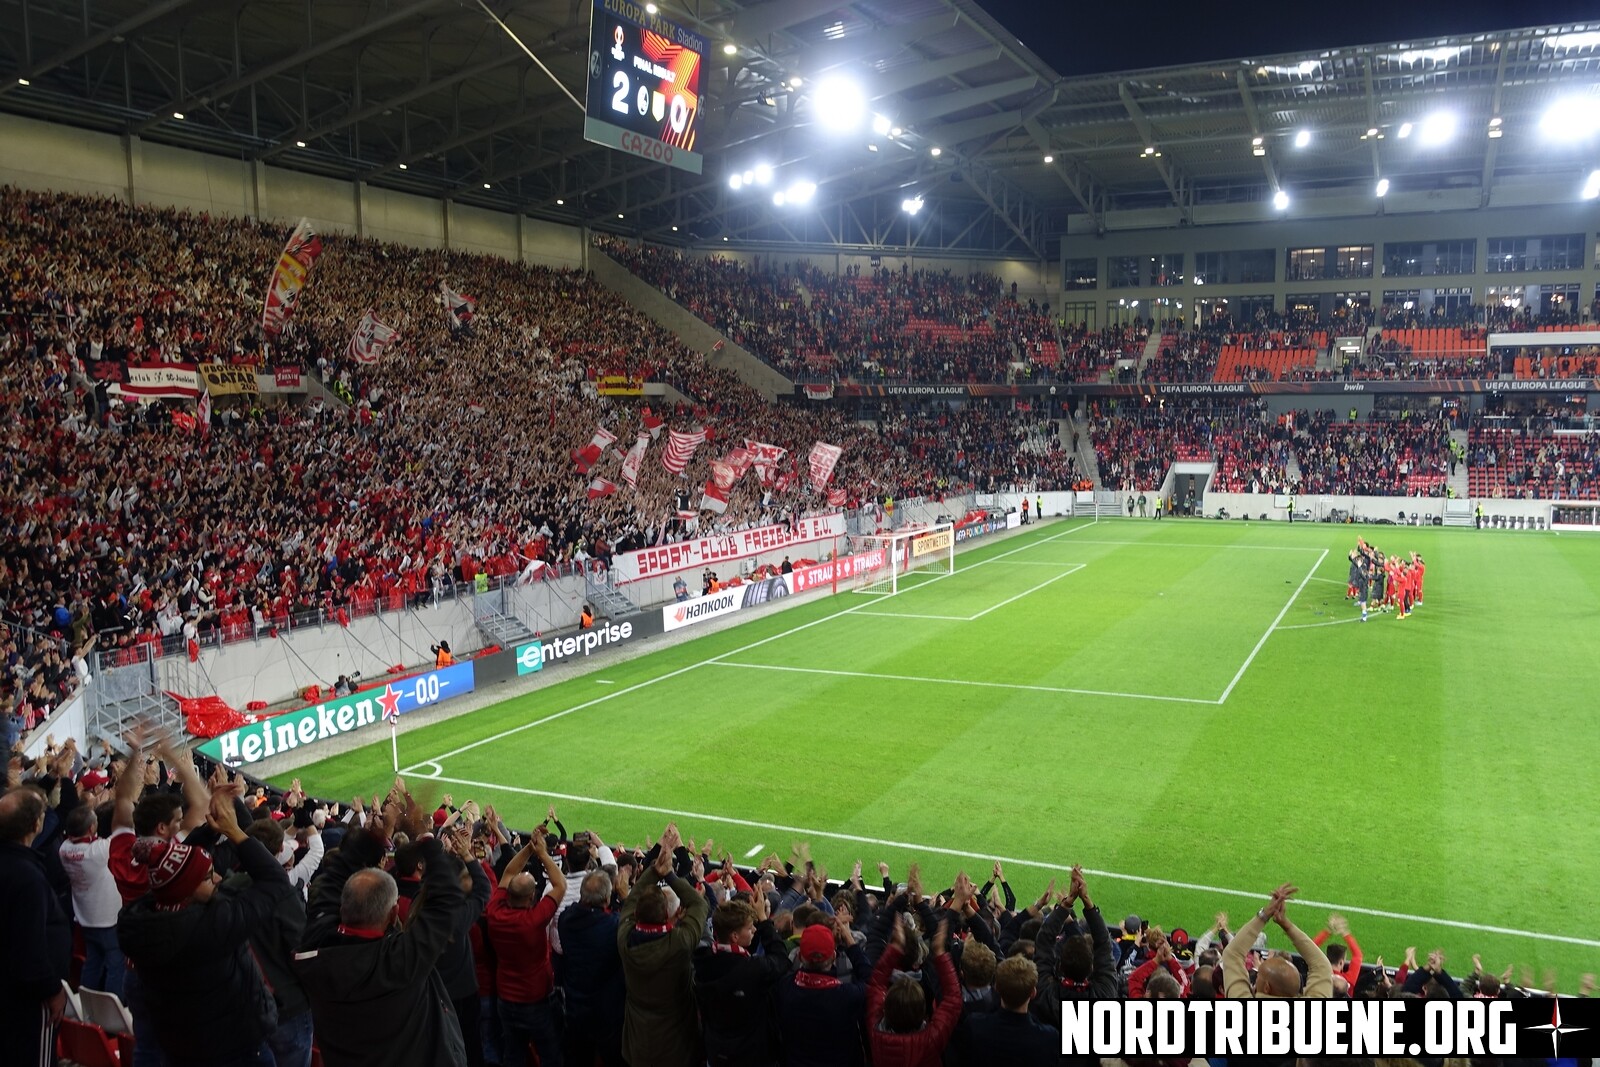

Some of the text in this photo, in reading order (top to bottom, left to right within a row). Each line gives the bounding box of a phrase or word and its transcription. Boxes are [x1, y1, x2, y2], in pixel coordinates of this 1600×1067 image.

[604, 0, 703, 53] EUROPA PARK Stadion
[611, 71, 630, 115] 2
[670, 94, 687, 134] 0
[621, 132, 673, 163] CAZOO
[203, 364, 254, 373] #BOYCOTT
[207, 372, 257, 386] QATAR
[888, 386, 964, 394] UEFA EUROPA LEAGUE
[1160, 385, 1245, 393] UEFA EUROPA LEAGUE
[1343, 383, 1364, 391] bwin
[1485, 381, 1587, 390] UEFA EUROPA LEAGUE
[917, 534, 950, 553] SPORTWETTEN
[637, 534, 738, 575] SPORT-CLUB
[853, 552, 882, 572] STRAUSS
[808, 563, 842, 585] STRAUS
[517, 621, 633, 668] enterprise
[220, 698, 376, 768] Heineken
